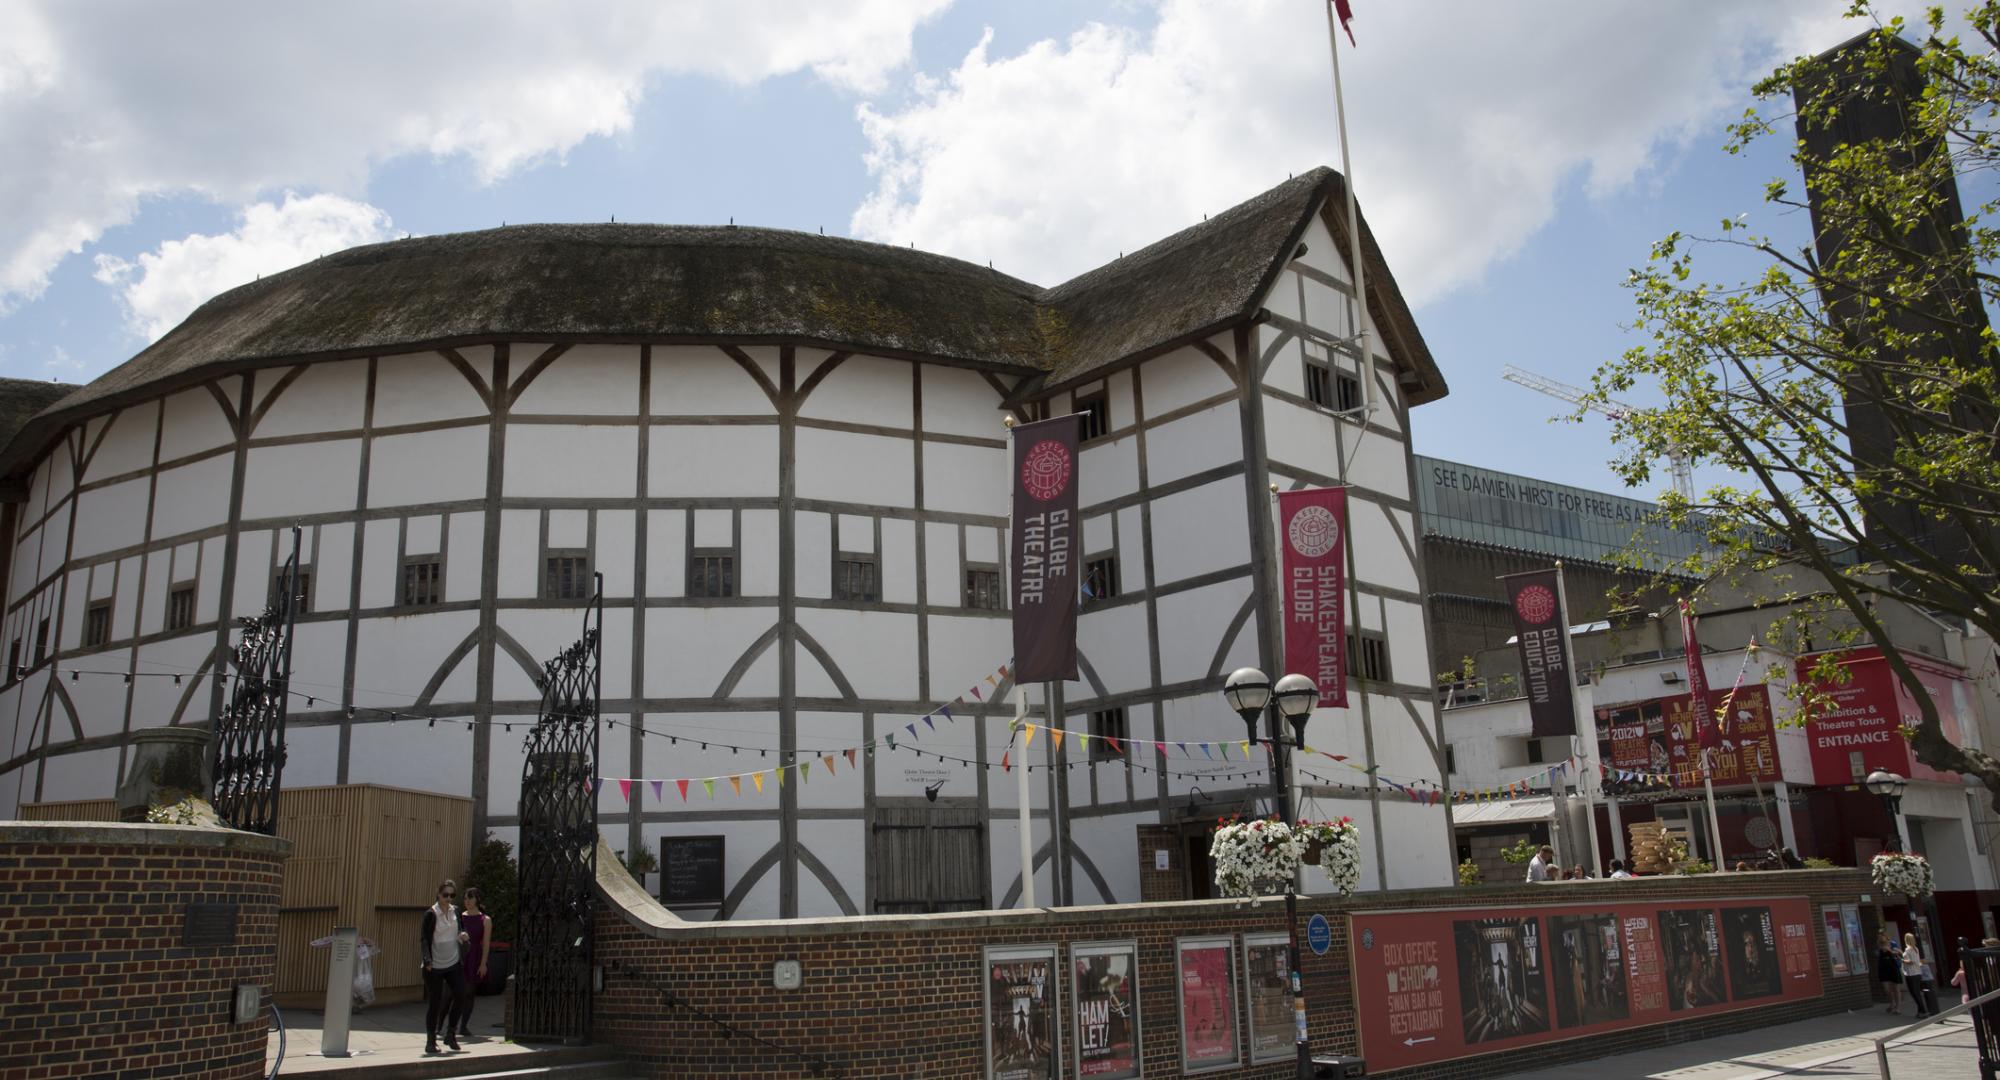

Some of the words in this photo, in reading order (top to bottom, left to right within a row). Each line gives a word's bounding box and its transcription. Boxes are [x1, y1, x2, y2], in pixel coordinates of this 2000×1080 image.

[1433, 467, 1458, 489] SEE
[1462, 473, 1516, 500] DAMIEN
[1518, 485, 1554, 507] HIRST
[1558, 492, 1583, 513] FOR
[1585, 498, 1614, 519] FREE
[1616, 504, 1632, 522] AS
[1634, 507, 1642, 521] A
[1048, 508, 1069, 579] GLOBE
[1298, 542, 1330, 555] GLOBE
[1020, 512, 1045, 605] THEATRE
[1293, 566, 1314, 624] GLOBE
[1317, 565, 1339, 702] SHAKESPEARE'S
[1542, 627, 1563, 672] GLOBE
[1522, 630, 1550, 704] EDUCATION
[1697, 696, 1711, 727] TOUR
[1868, 704, 1877, 714] &
[1816, 719, 1855, 731] Theatre
[1857, 717, 1886, 727] Tours
[1817, 731, 1890, 748] ENTRANCE
[1714, 753, 1738, 768] YOU
[1758, 734, 1775, 775] TWELFTH
[1383, 944, 1403, 966] BOX
[1405, 941, 1439, 963] OFFICE
[1624, 918, 1639, 977] THEATRE
[1398, 966, 1426, 992] SHOP
[1080, 1000, 1109, 1025] HAM
[1387, 994, 1410, 1012] SWAN
[1411, 992, 1426, 1010] BAR
[1428, 990, 1442, 1008] AND
[1389, 1009, 1444, 1036] RESTAURANT
